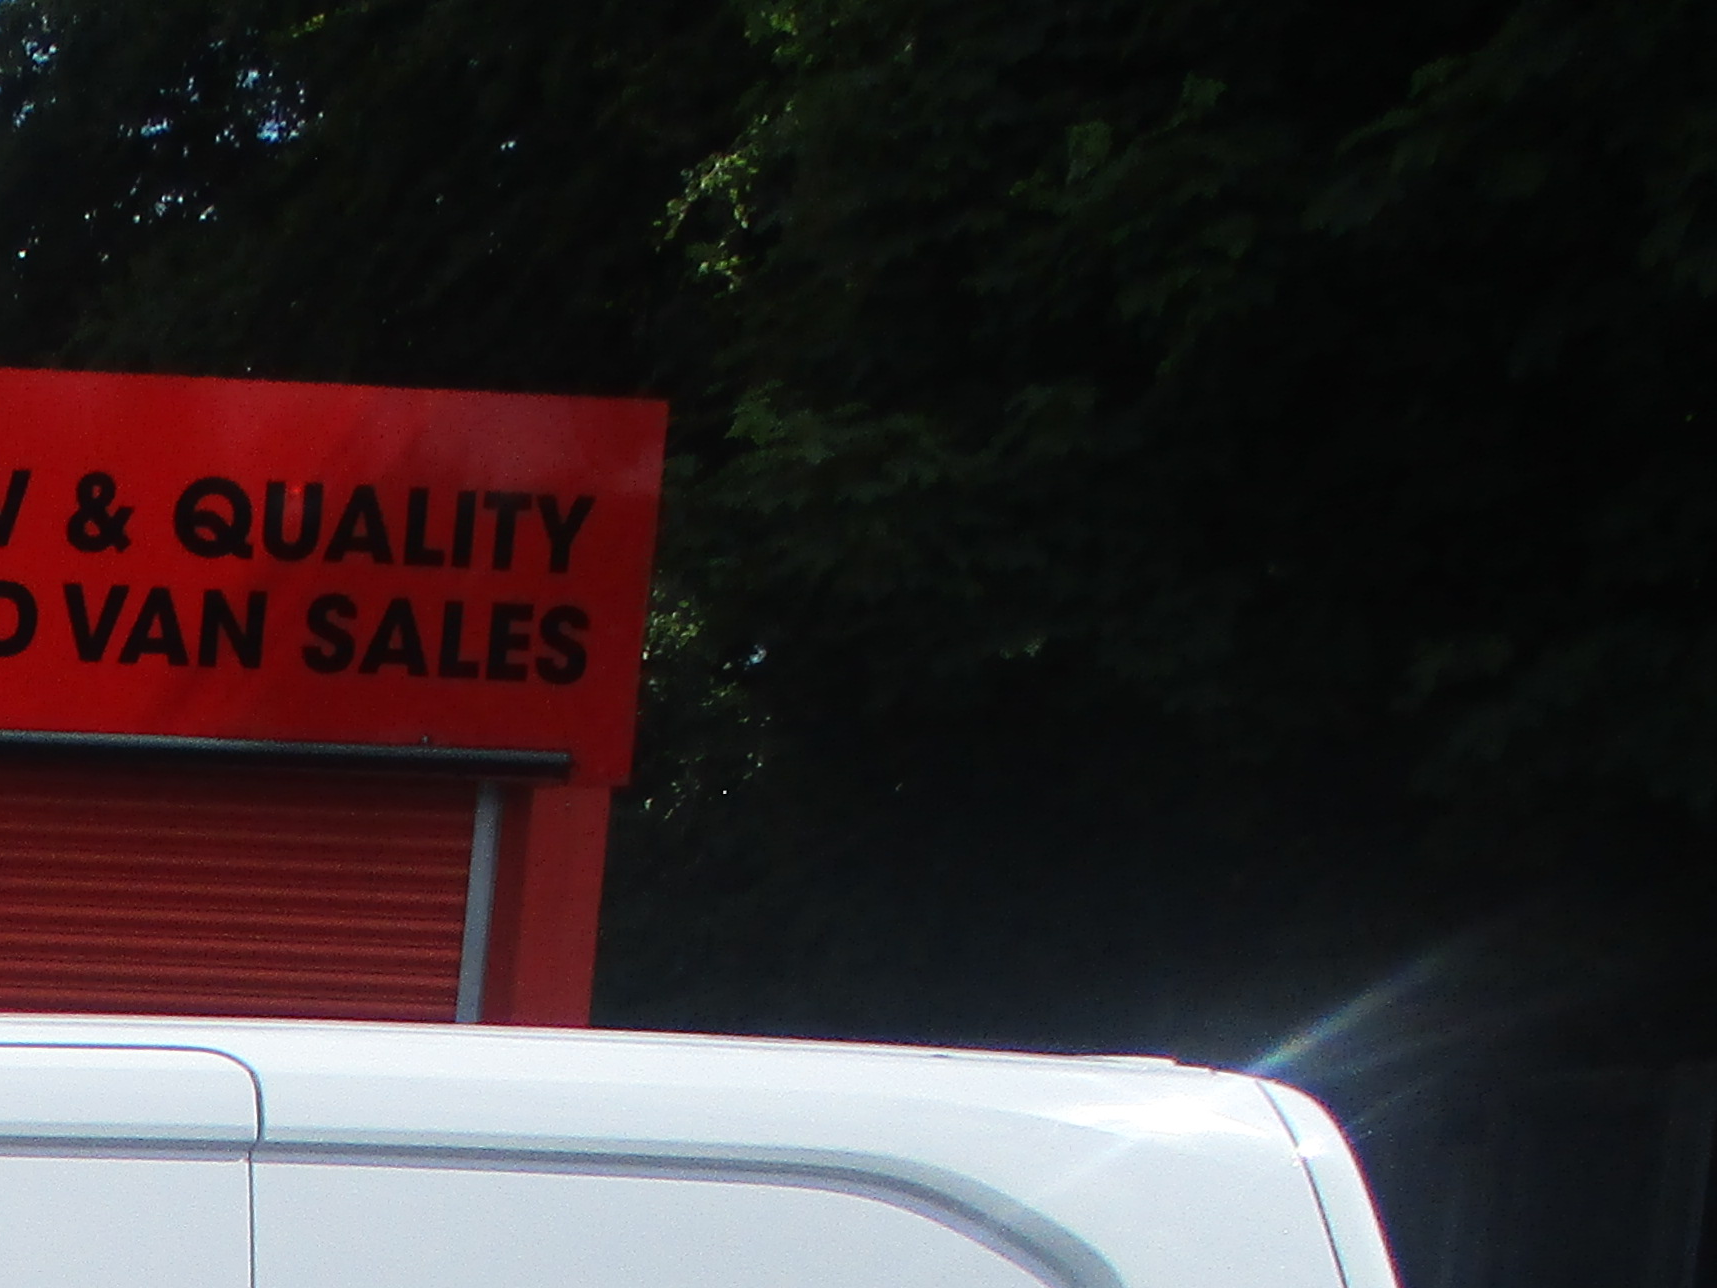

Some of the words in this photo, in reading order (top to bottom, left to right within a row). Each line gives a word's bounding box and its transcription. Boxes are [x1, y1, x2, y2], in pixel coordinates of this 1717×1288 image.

[67, 471, 133, 553] &
[173, 476, 597, 574] QUALITY
[63, 583, 269, 671] VAN
[301, 592, 593, 686] SALES
